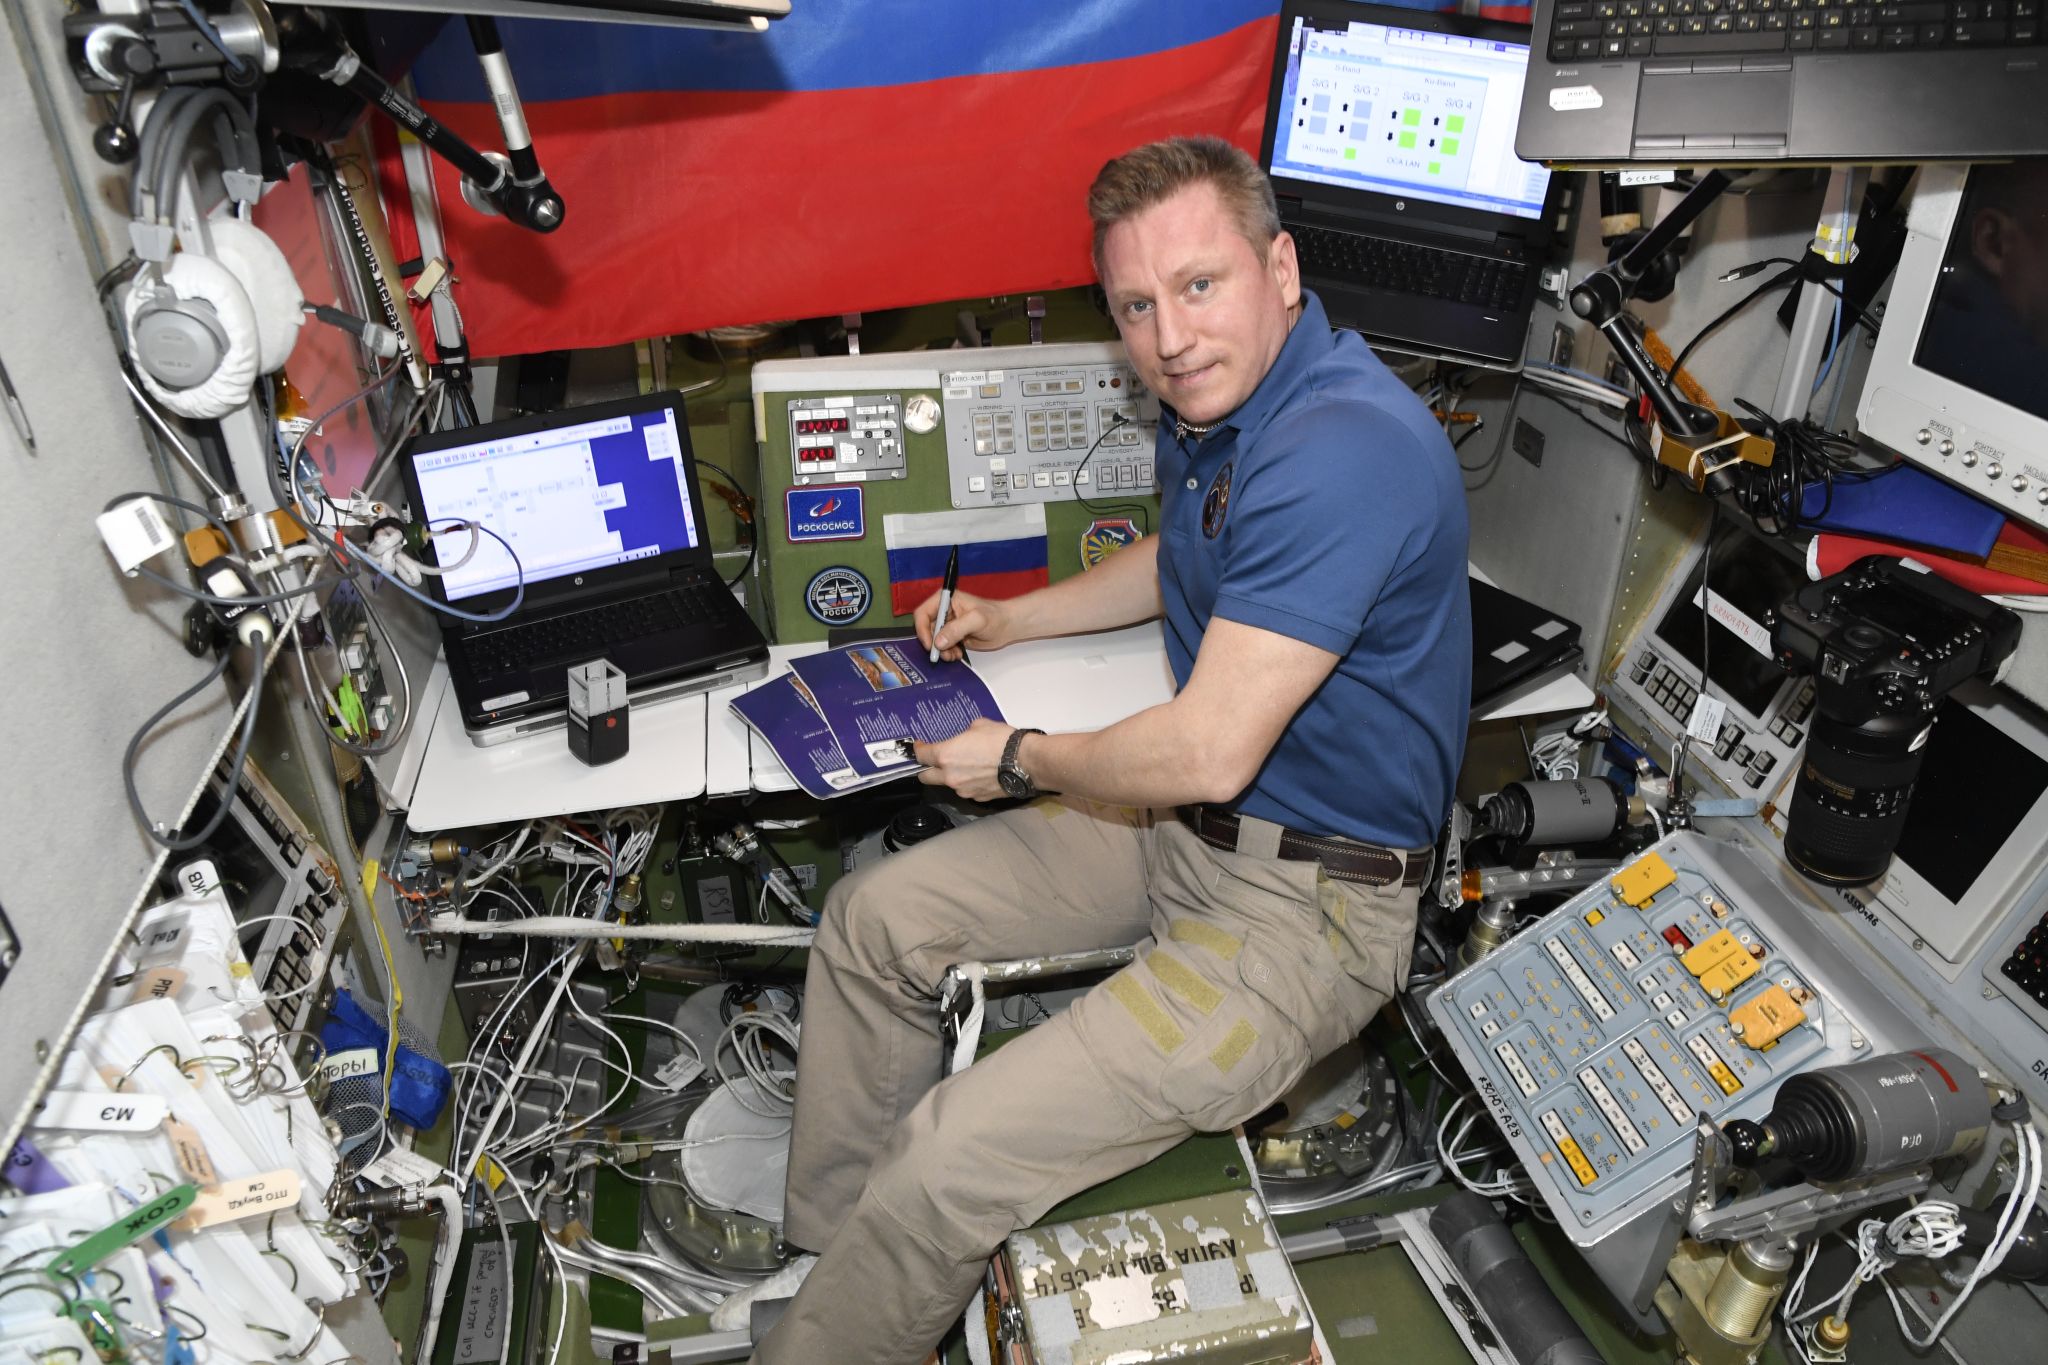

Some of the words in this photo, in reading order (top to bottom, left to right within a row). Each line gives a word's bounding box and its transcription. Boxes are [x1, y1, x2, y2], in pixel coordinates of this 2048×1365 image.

[1312, 79, 1330, 89] S/G
[1354, 85, 1371, 94] S/G
[1373, 87, 1380, 96] 2
[1402, 92, 1421, 102] S/G
[1423, 95, 1430, 104] 3
[1445, 98, 1463, 109] S/G
[1404, 160, 1420, 169] LAN
[1974, 440, 2005, 459] КОНТРАСТ
[798, 521, 855, 532] РОСКОСМОС
[823, 606, 859, 617] РОССИЯ
[101, 1107, 135, 1121] МЭ
[248, 1182, 265, 1192] СМ
[265, 1189, 288, 1201] ПТО
[127, 1196, 180, 1233] СОЖ
[461, 1337, 473, 1359] Call
